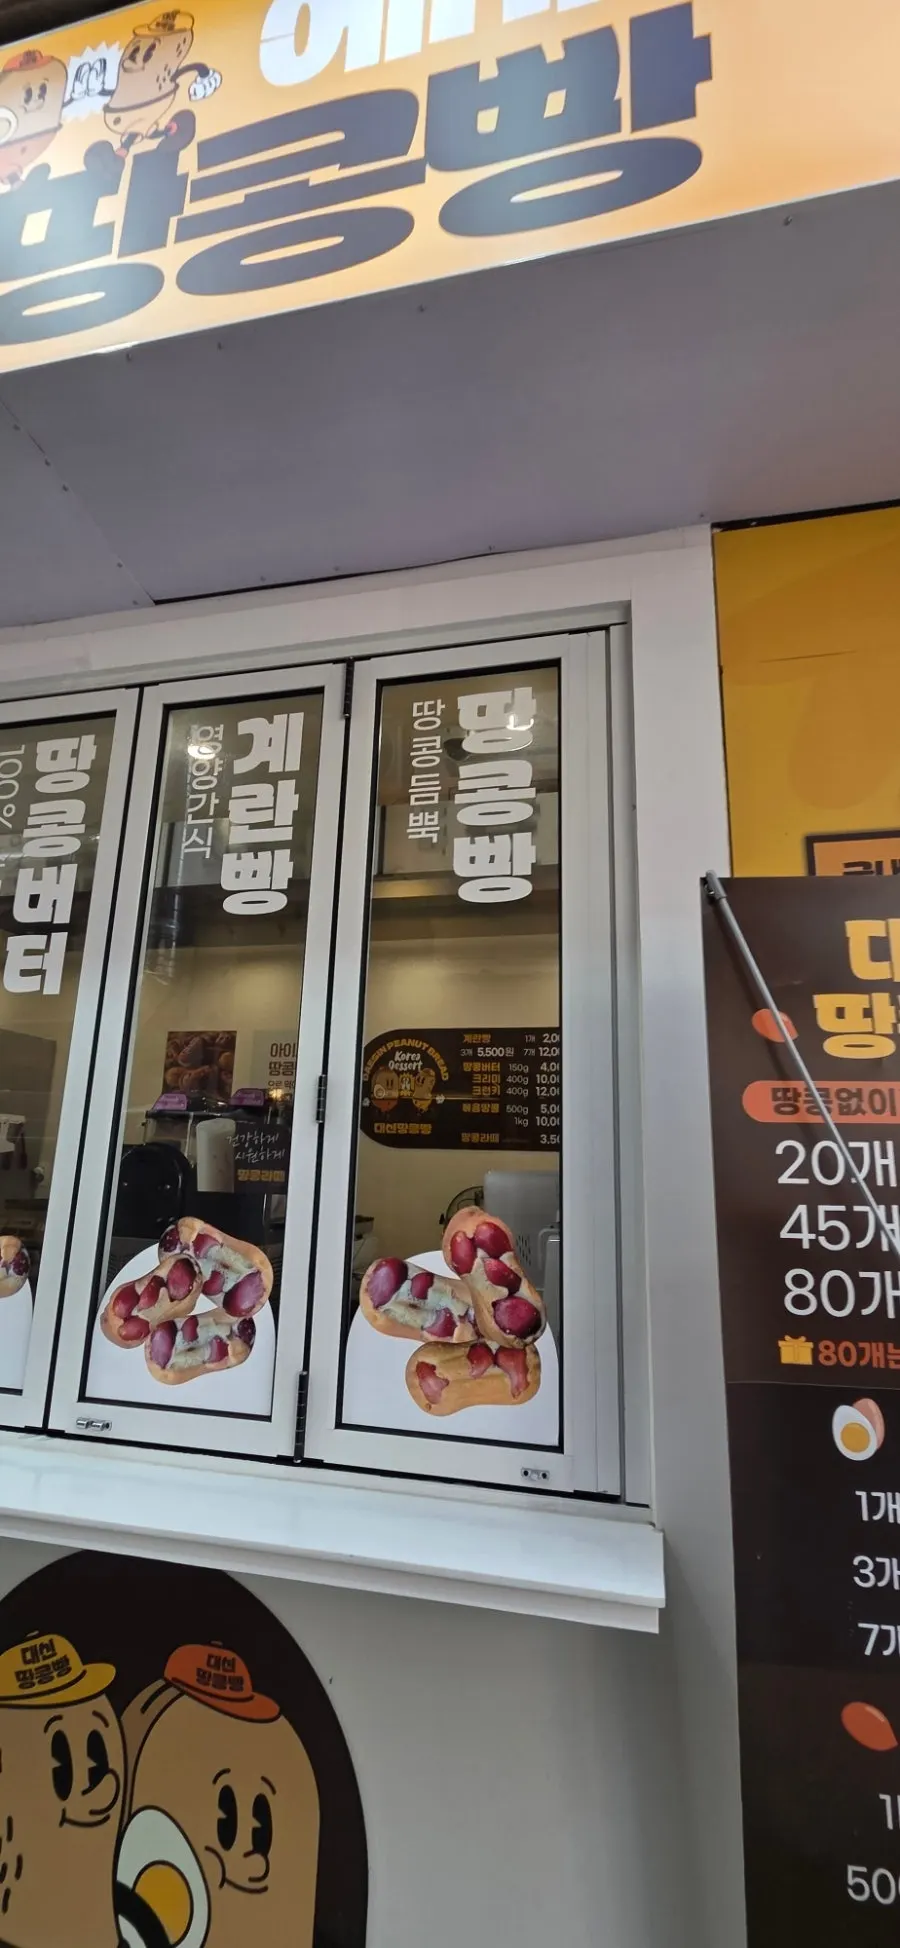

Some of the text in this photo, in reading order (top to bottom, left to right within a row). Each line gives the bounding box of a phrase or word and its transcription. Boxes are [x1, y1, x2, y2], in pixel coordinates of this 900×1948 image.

[0, 1, 714, 345] 땅콩빵
[407, 699, 446, 844] 땅콩듬뿍
[182, 724, 225, 859] 영양간식
[453, 687, 537, 904] 땅콩빵
[221, 712, 304, 915] 계란빵
[3, 734, 97, 995] 땅콩버터
[812, 992, 900, 1060] 땅
[386, 1038, 429, 1051] PEANUT
[525, 1034, 536, 1043] 1개
[394, 1050, 421, 1062] Korea
[460, 1047, 473, 1057] 3개
[523, 1047, 536, 1057] 7개
[388, 1060, 423, 1073] Dessert
[463, 1061, 500, 1072] 땅콩버터
[509, 1063, 529, 1074] 150g
[506, 1074, 529, 1085] 400g
[506, 1086, 529, 1098] 400g
[506, 1104, 529, 1115] 500g
[514, 1116, 529, 1127] 1kg
[226, 1130, 279, 1148] 건강하게
[235, 1145, 286, 1163] 시원하게
[775, 1139, 898, 1188] 20개
[878, 1793, 900, 1831] 1
[846, 1864, 900, 1906] 50
